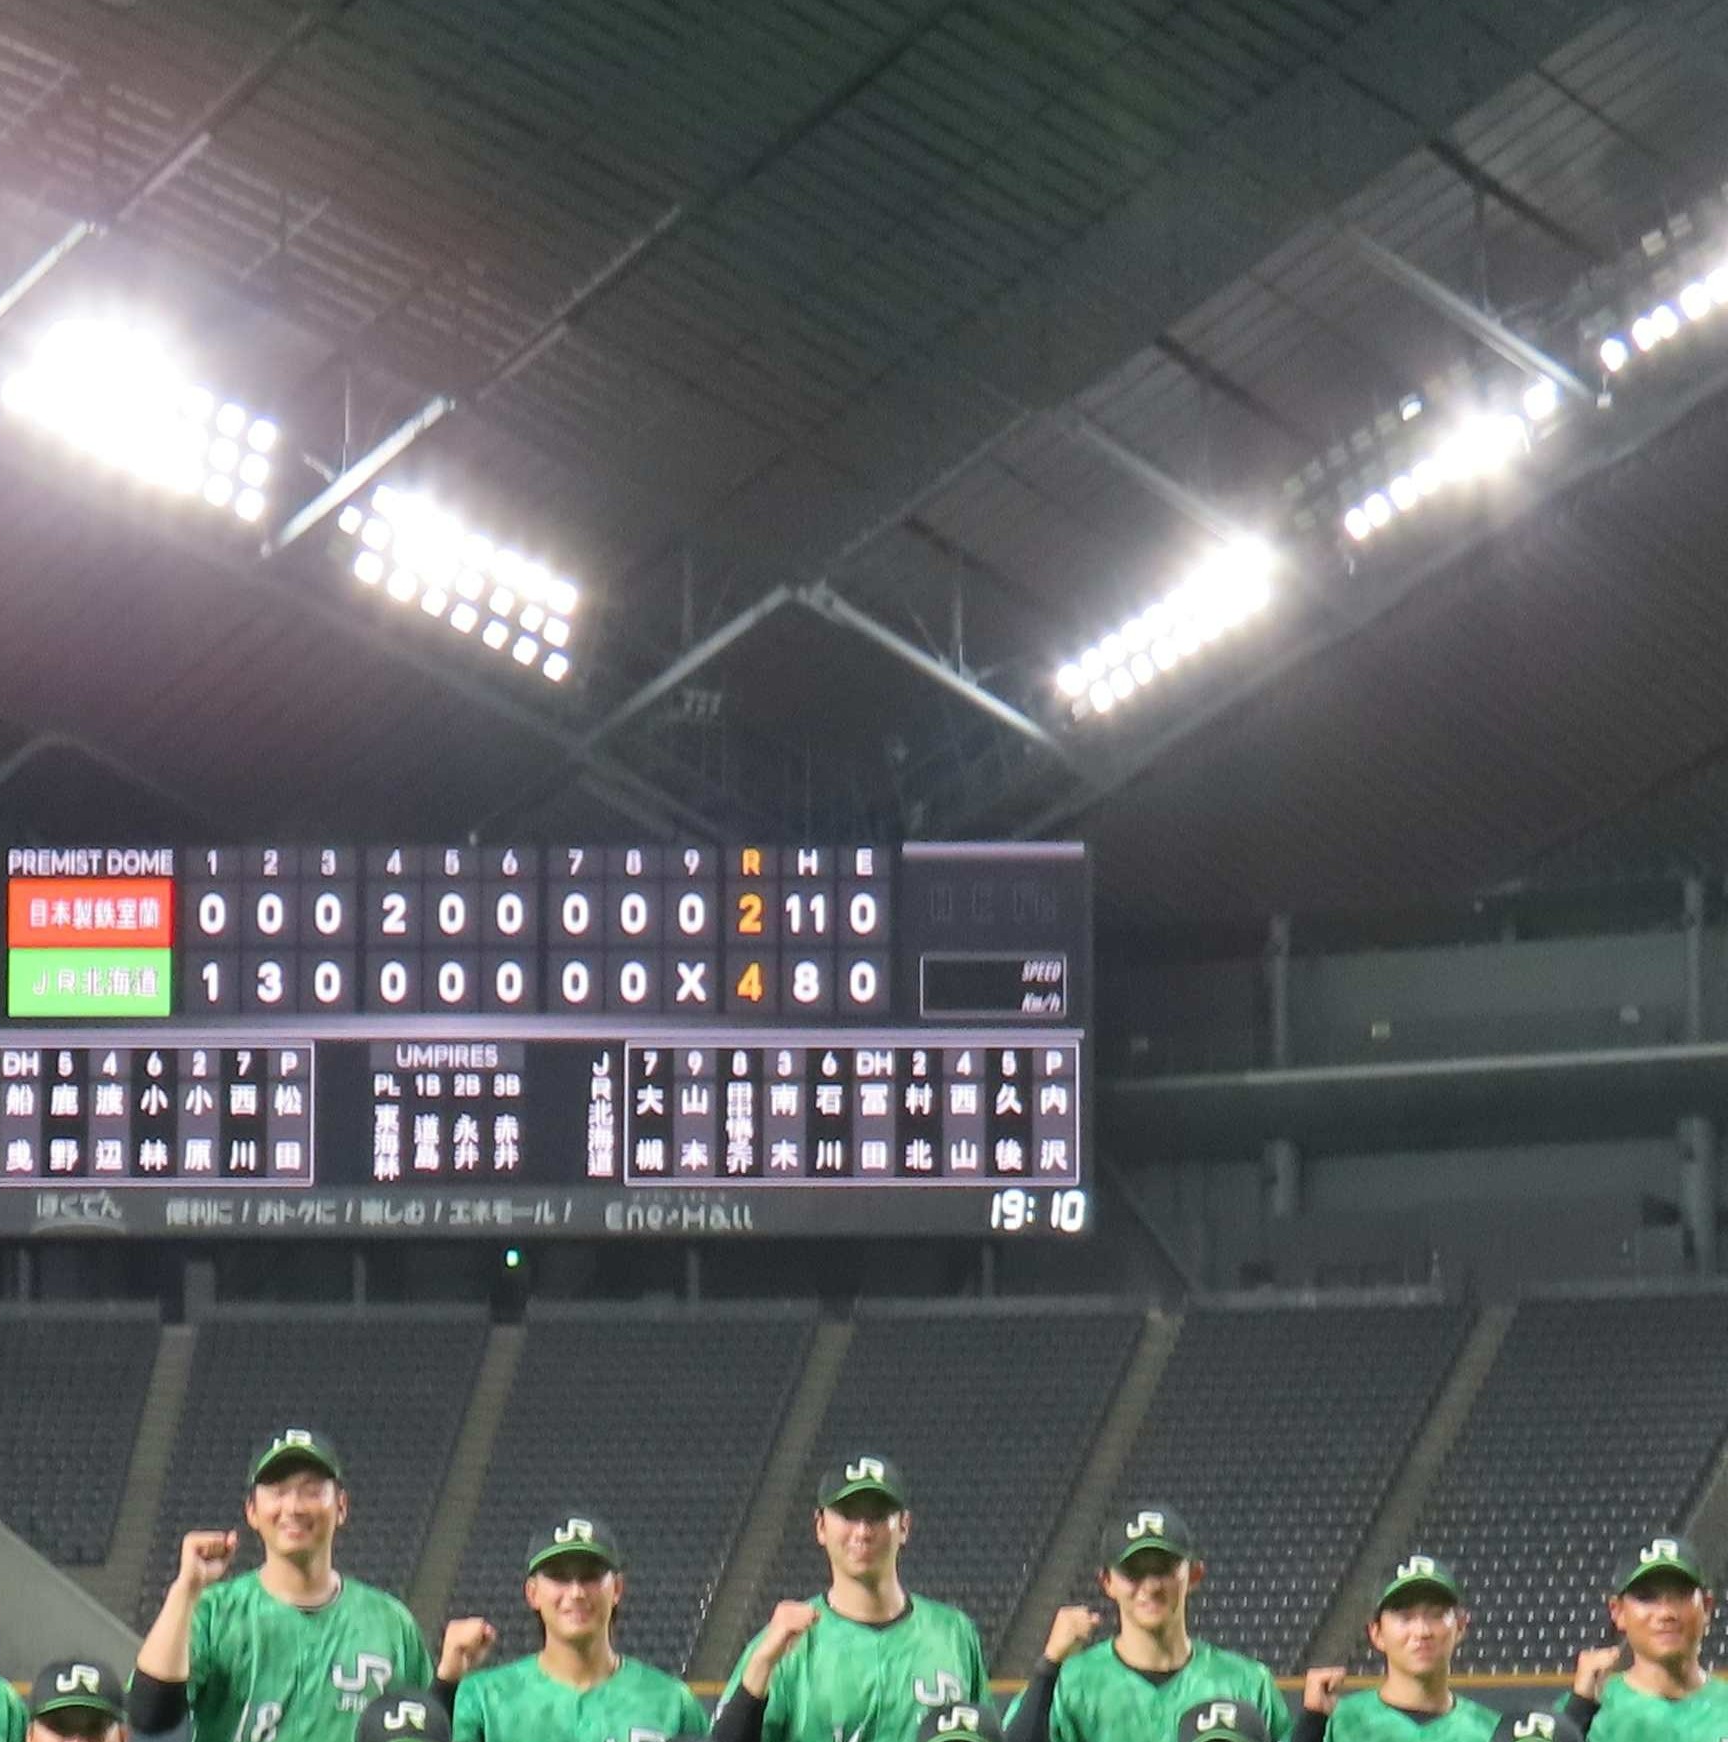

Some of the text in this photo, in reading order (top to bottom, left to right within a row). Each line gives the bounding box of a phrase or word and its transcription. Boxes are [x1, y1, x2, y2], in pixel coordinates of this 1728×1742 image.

[8, 849, 174, 877] PREMIST DOME
[207, 848, 873, 876] 1 2 3 4 5 6 7 8 9 R H E
[199, 892, 877, 935] 0 0 0 2 0 0 0 0 0 2 11 0
[202, 960, 877, 1003] 1 3 0 0 0 0 0 0 X 4 8 0
[1022, 960, 1062, 982] SPEED
[2, 1051, 40, 1077] DH
[58, 1050, 73, 1077] 5
[102, 1050, 118, 1076] 4
[146, 1050, 163, 1077] 6
[192, 1049, 207, 1077] 2
[236, 1051, 252, 1076] 7
[280, 1050, 298, 1077] P
[395, 1043, 499, 1069] UMPIRES
[643, 1049, 1063, 1077] 7 9 8 3 6 DH 2 4 5 P
[374, 1074, 520, 1097] PL 1B 2B 3B
[229, 1084, 257, 1171] 西川
[815, 1084, 843, 1171] 石川
[950, 1084, 978, 1170] 西山
[846, 1456, 884, 1482] JR
[555, 1517, 593, 1544] JR
[1126, 1511, 1164, 1538] JR
[1640, 1539, 1679, 1564] JR
[1397, 1555, 1435, 1579] JR
[56, 1663, 100, 1695] JR
[332, 1652, 393, 1696] JR
[384, 1701, 427, 1732] JR
[938, 1706, 979, 1732] JR
[1197, 1703, 1236, 1730] JR
[1514, 1713, 1555, 1739] JR
